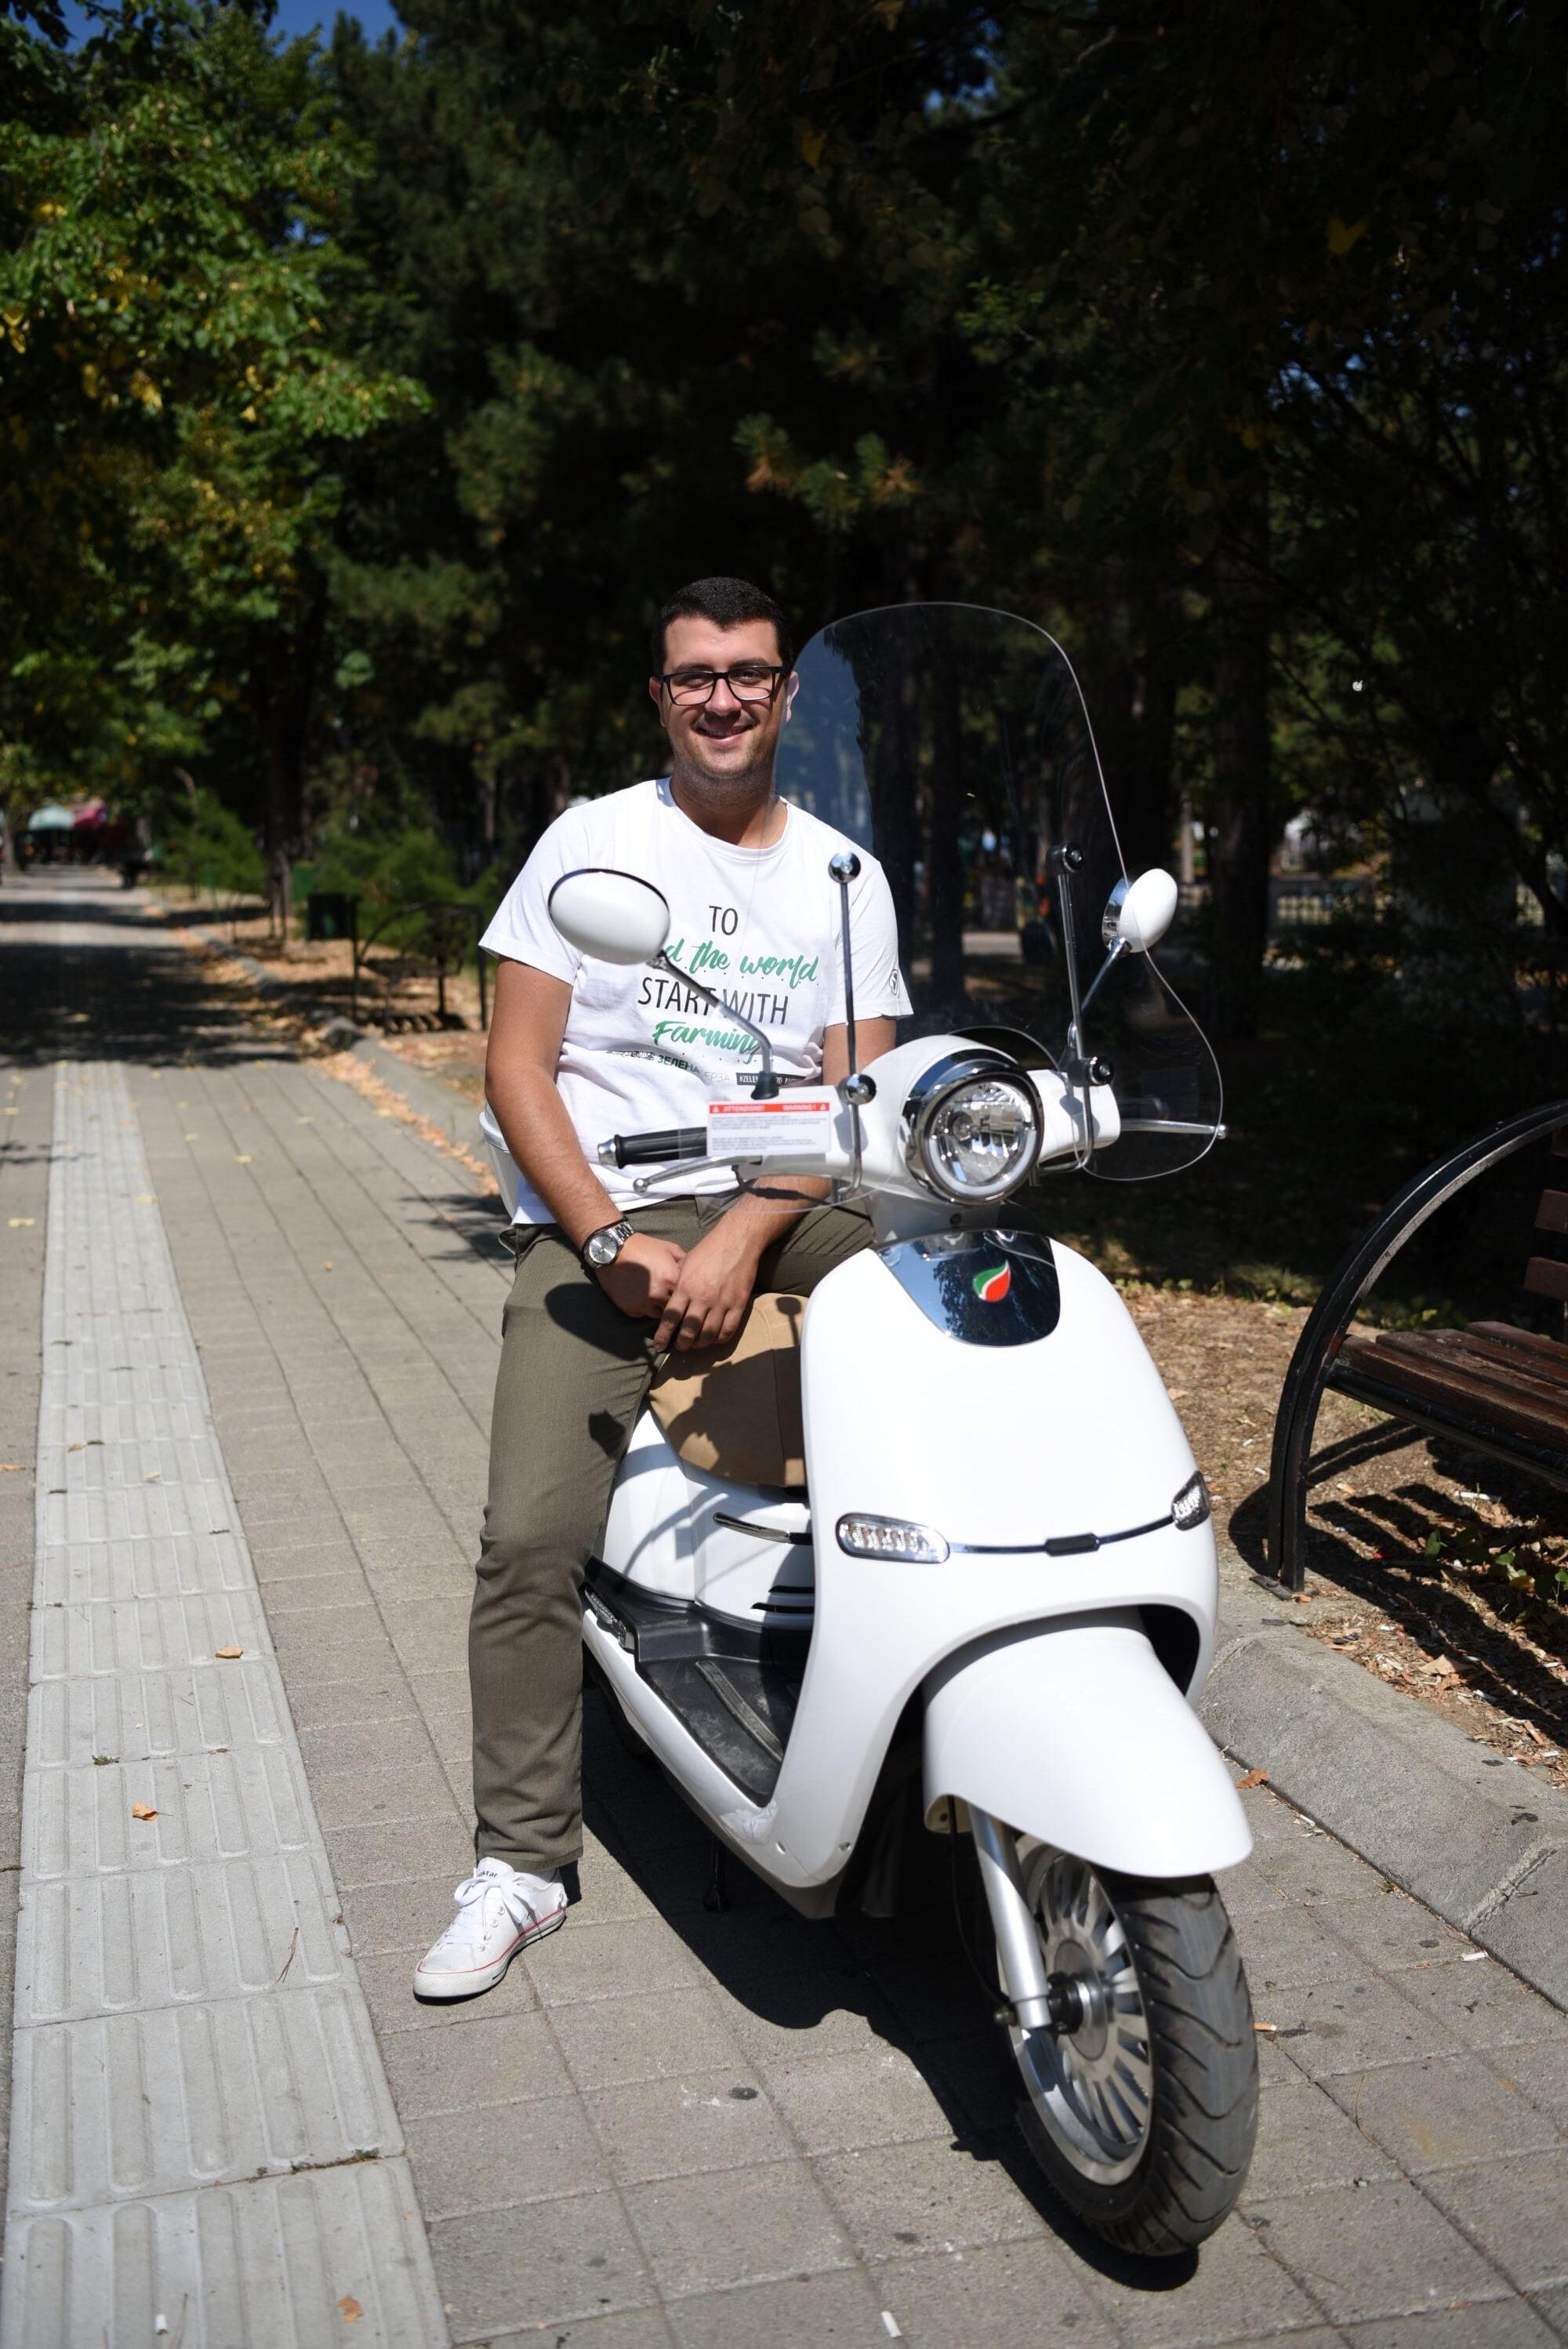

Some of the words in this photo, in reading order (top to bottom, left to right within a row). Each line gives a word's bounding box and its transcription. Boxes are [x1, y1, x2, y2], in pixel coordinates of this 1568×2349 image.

[709, 905, 739, 935] TO
[689, 940, 731, 974] the
[739, 953, 819, 989] world
[723, 989, 789, 1026] WITH
[652, 1020, 761, 1065] Farming
